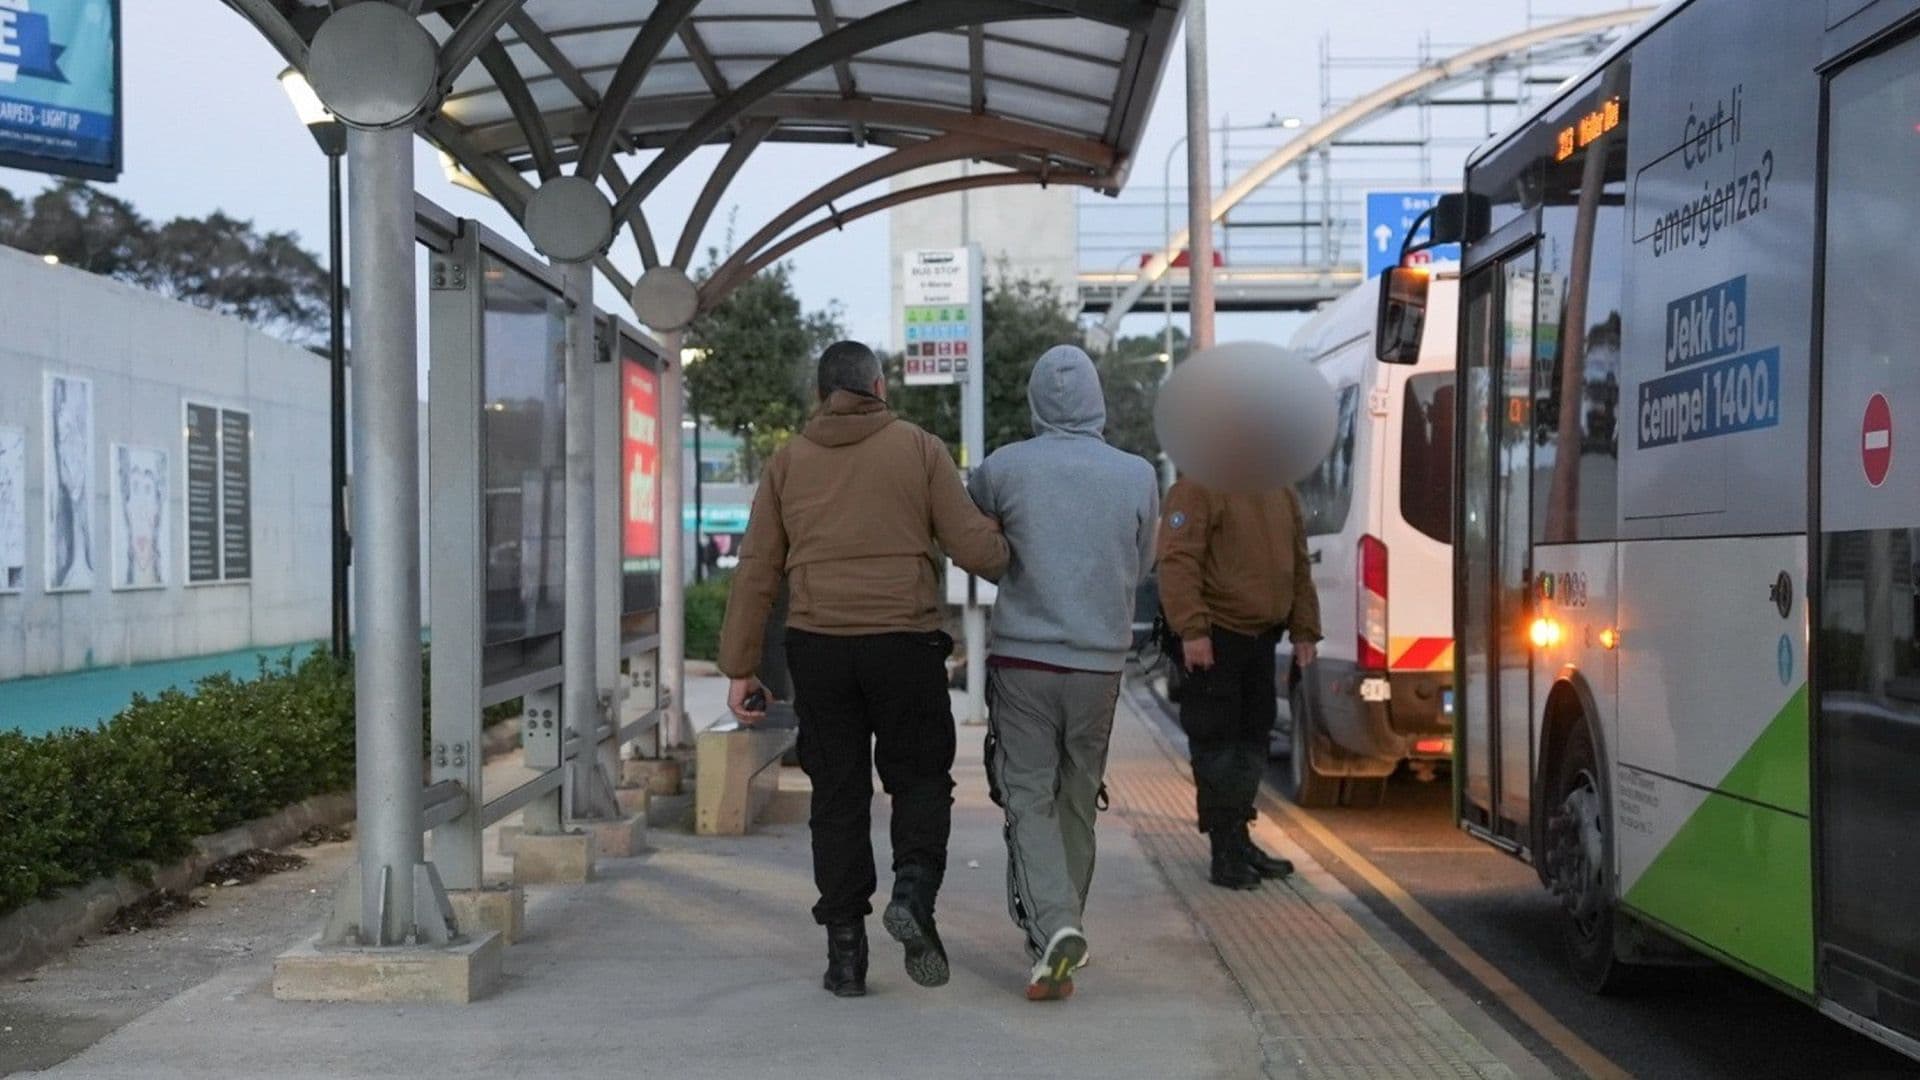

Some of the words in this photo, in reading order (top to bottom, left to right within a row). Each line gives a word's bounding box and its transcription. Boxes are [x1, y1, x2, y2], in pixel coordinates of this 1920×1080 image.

[1684, 102, 1724, 170] Ċert
[1731, 84, 1742, 145] li
[1653, 150, 1774, 258] emerġenza?
[1668, 295, 1713, 363] Jekk
[1717, 289, 1743, 351] le,
[1641, 372, 1708, 442] ċempel
[1713, 360, 1774, 428] 1400.
